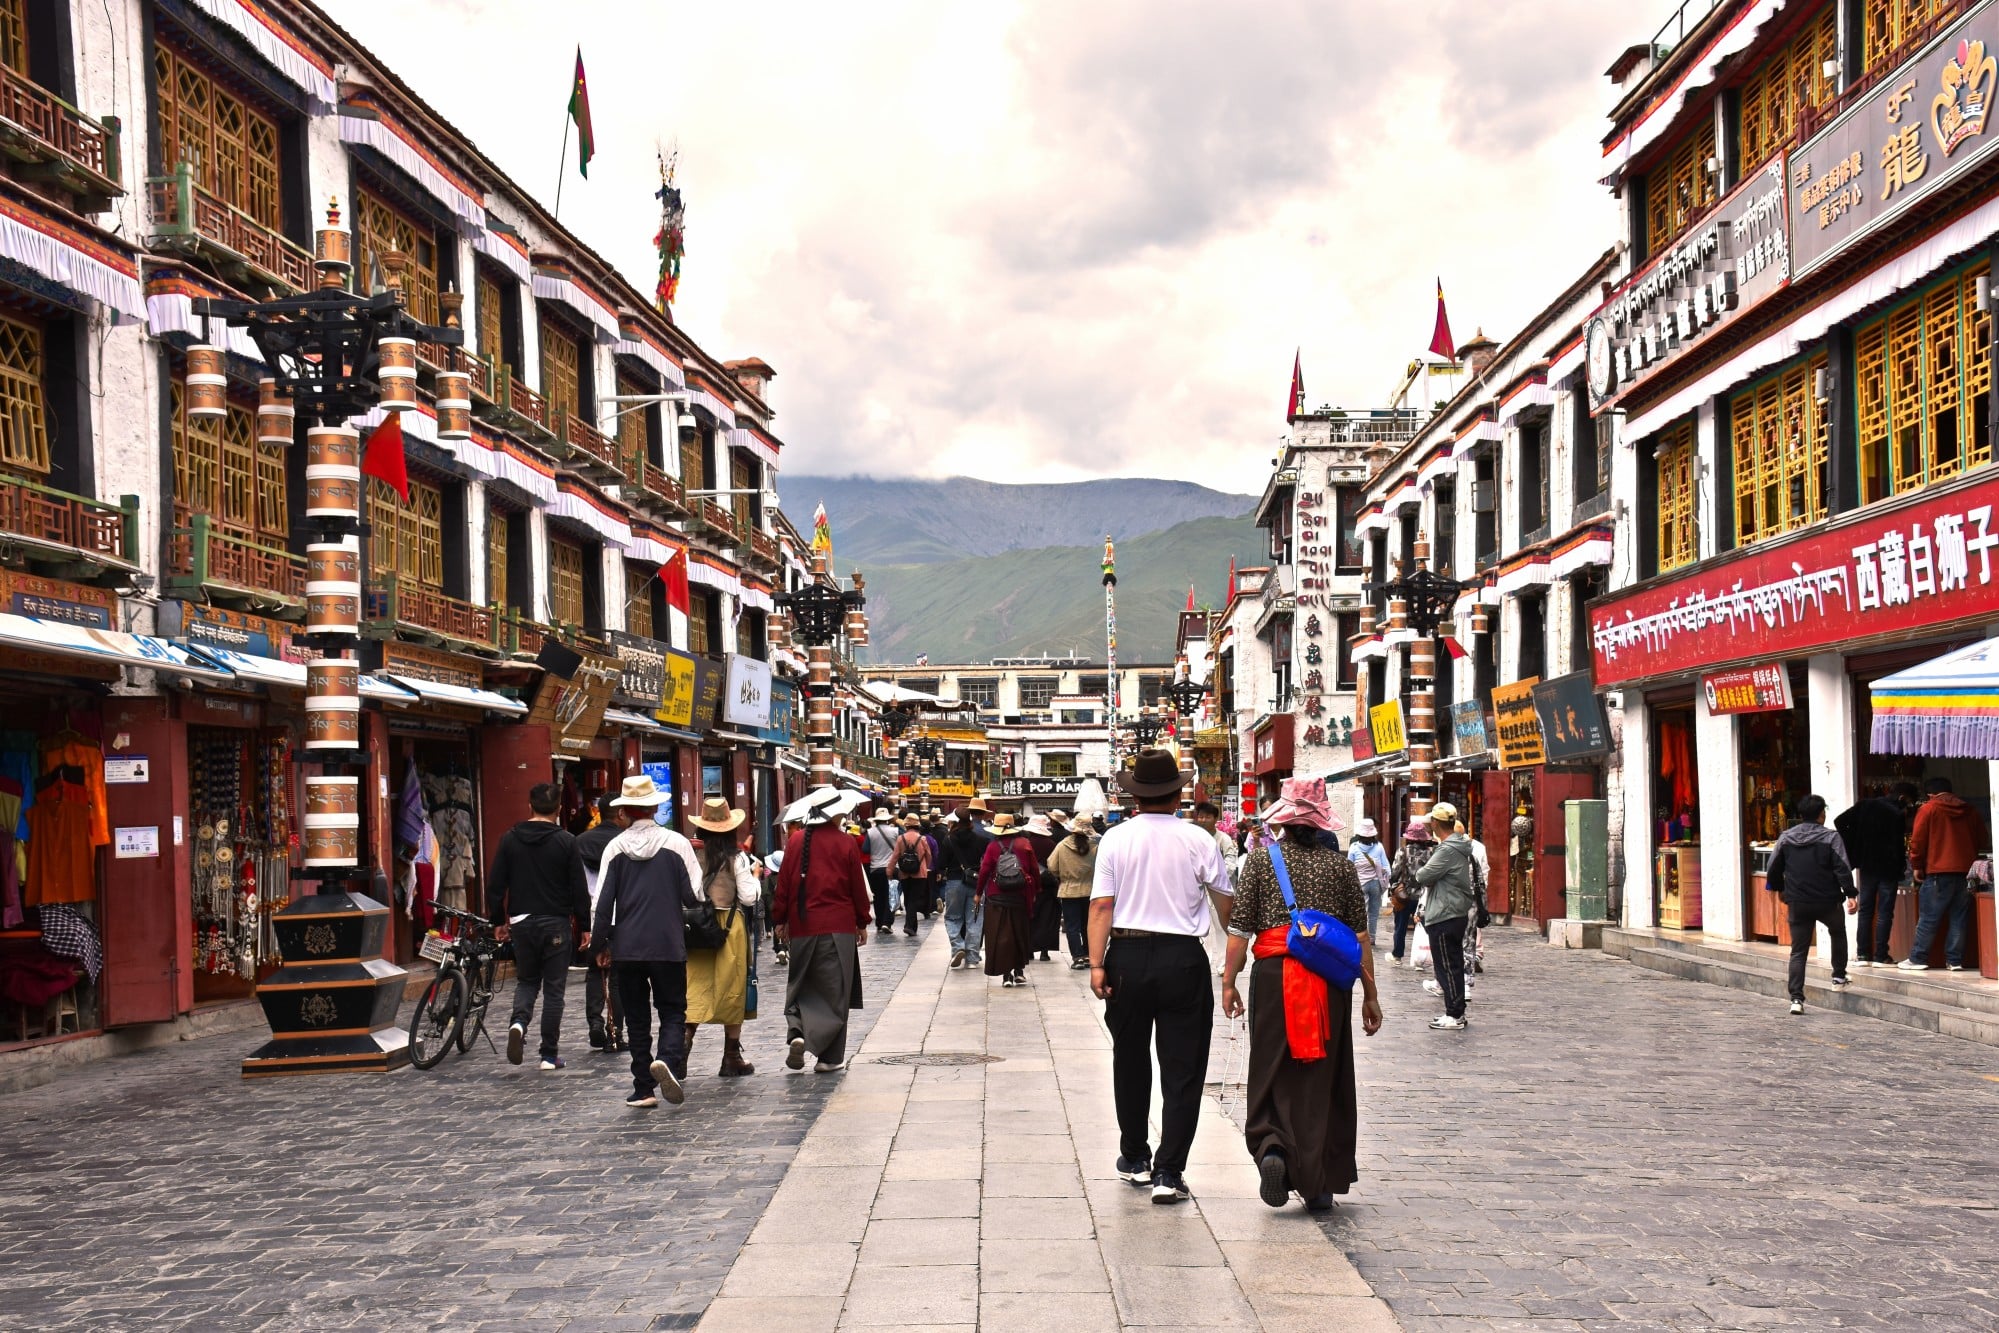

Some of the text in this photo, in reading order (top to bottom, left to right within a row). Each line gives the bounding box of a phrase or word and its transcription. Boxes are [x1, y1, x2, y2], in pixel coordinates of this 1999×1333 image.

[1879, 121, 1927, 201] 龍
[1852, 504, 1999, 611] 西藏白狮子
[1029, 783, 1083, 793] POP MAR
